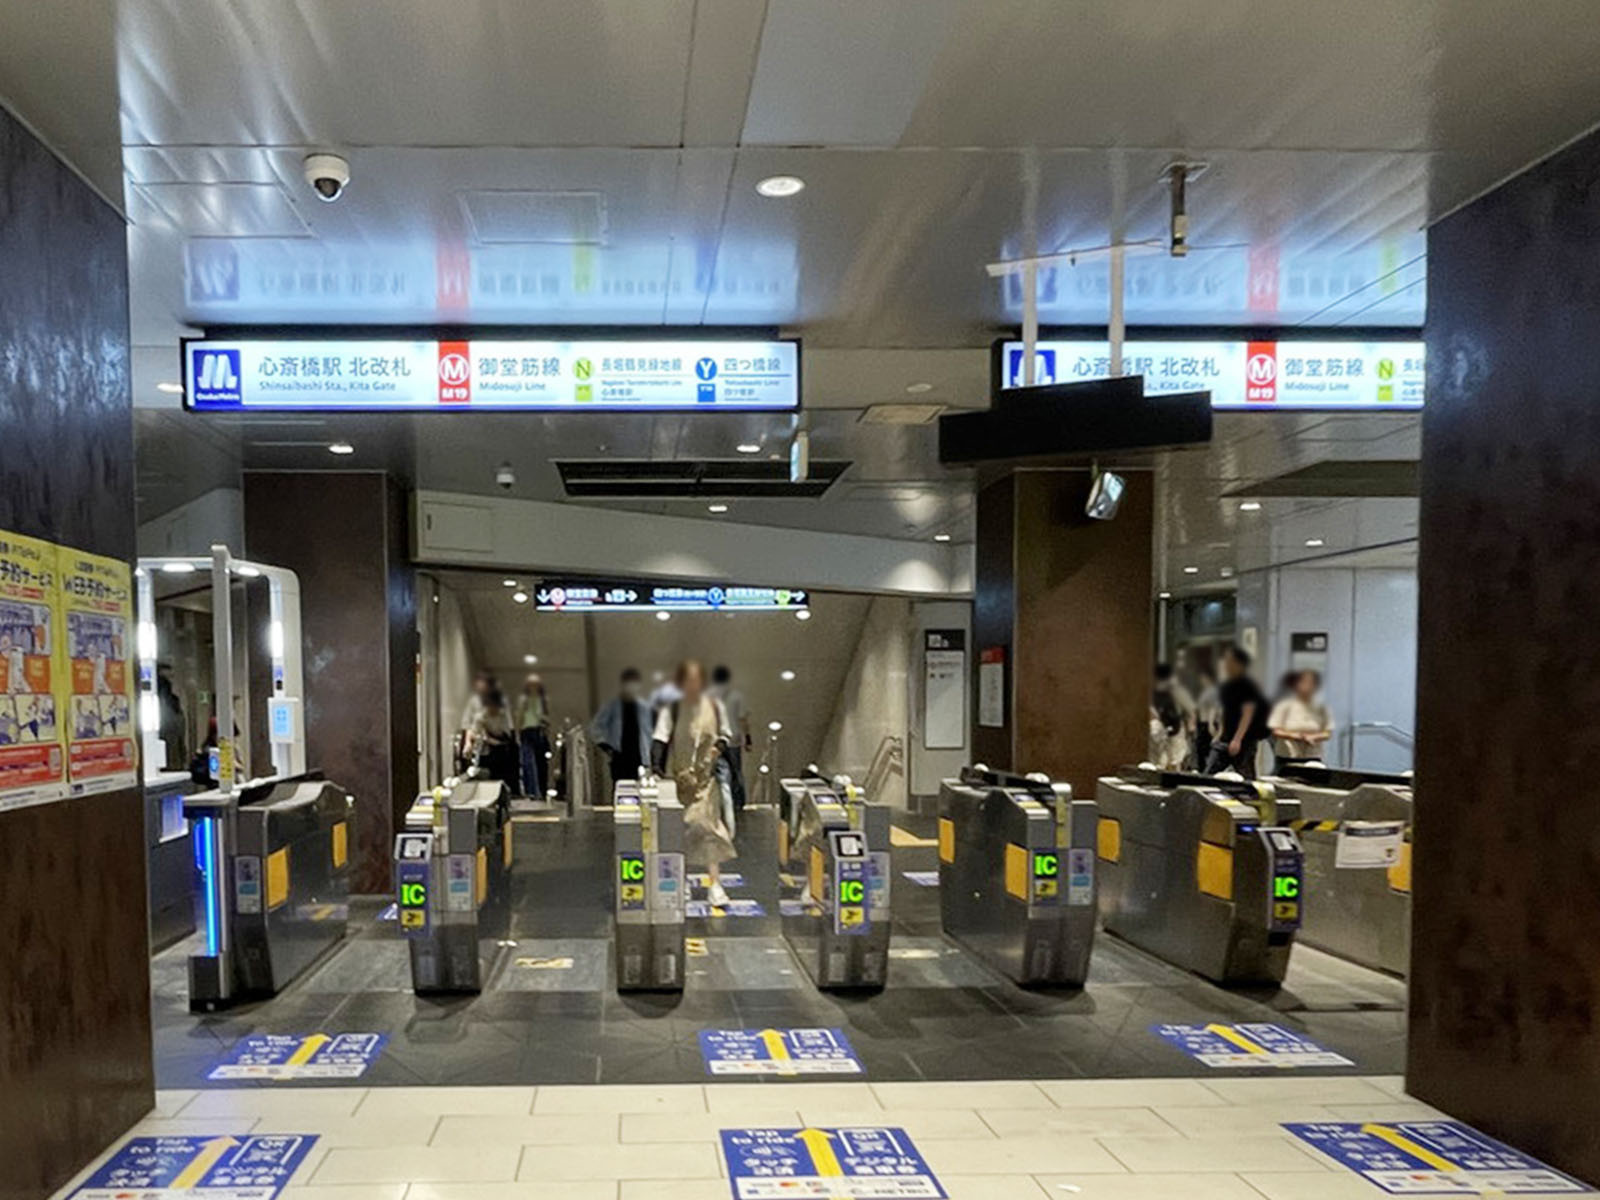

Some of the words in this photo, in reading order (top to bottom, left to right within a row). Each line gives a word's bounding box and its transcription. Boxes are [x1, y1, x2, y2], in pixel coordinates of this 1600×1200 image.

[258, 356, 342, 377] 心斎橋駅
[349, 356, 411, 377] 北改札
[479, 357, 561, 377] 御堂筋線
[576, 360, 591, 378] N
[699, 360, 713, 379] Y
[724, 357, 781, 372] 四つ橋線
[1160, 356, 1220, 377] 北改札
[1285, 357, 1364, 377] 御堂筋線
[1378, 359, 1394, 379] N
[442, 388, 468, 400] M19
[525, 381, 546, 391] Line
[622, 860, 644, 880] IC
[1034, 855, 1057, 875] IC
[401, 883, 425, 905] IC
[840, 881, 864, 902] IC
[1275, 876, 1298, 897] IC
